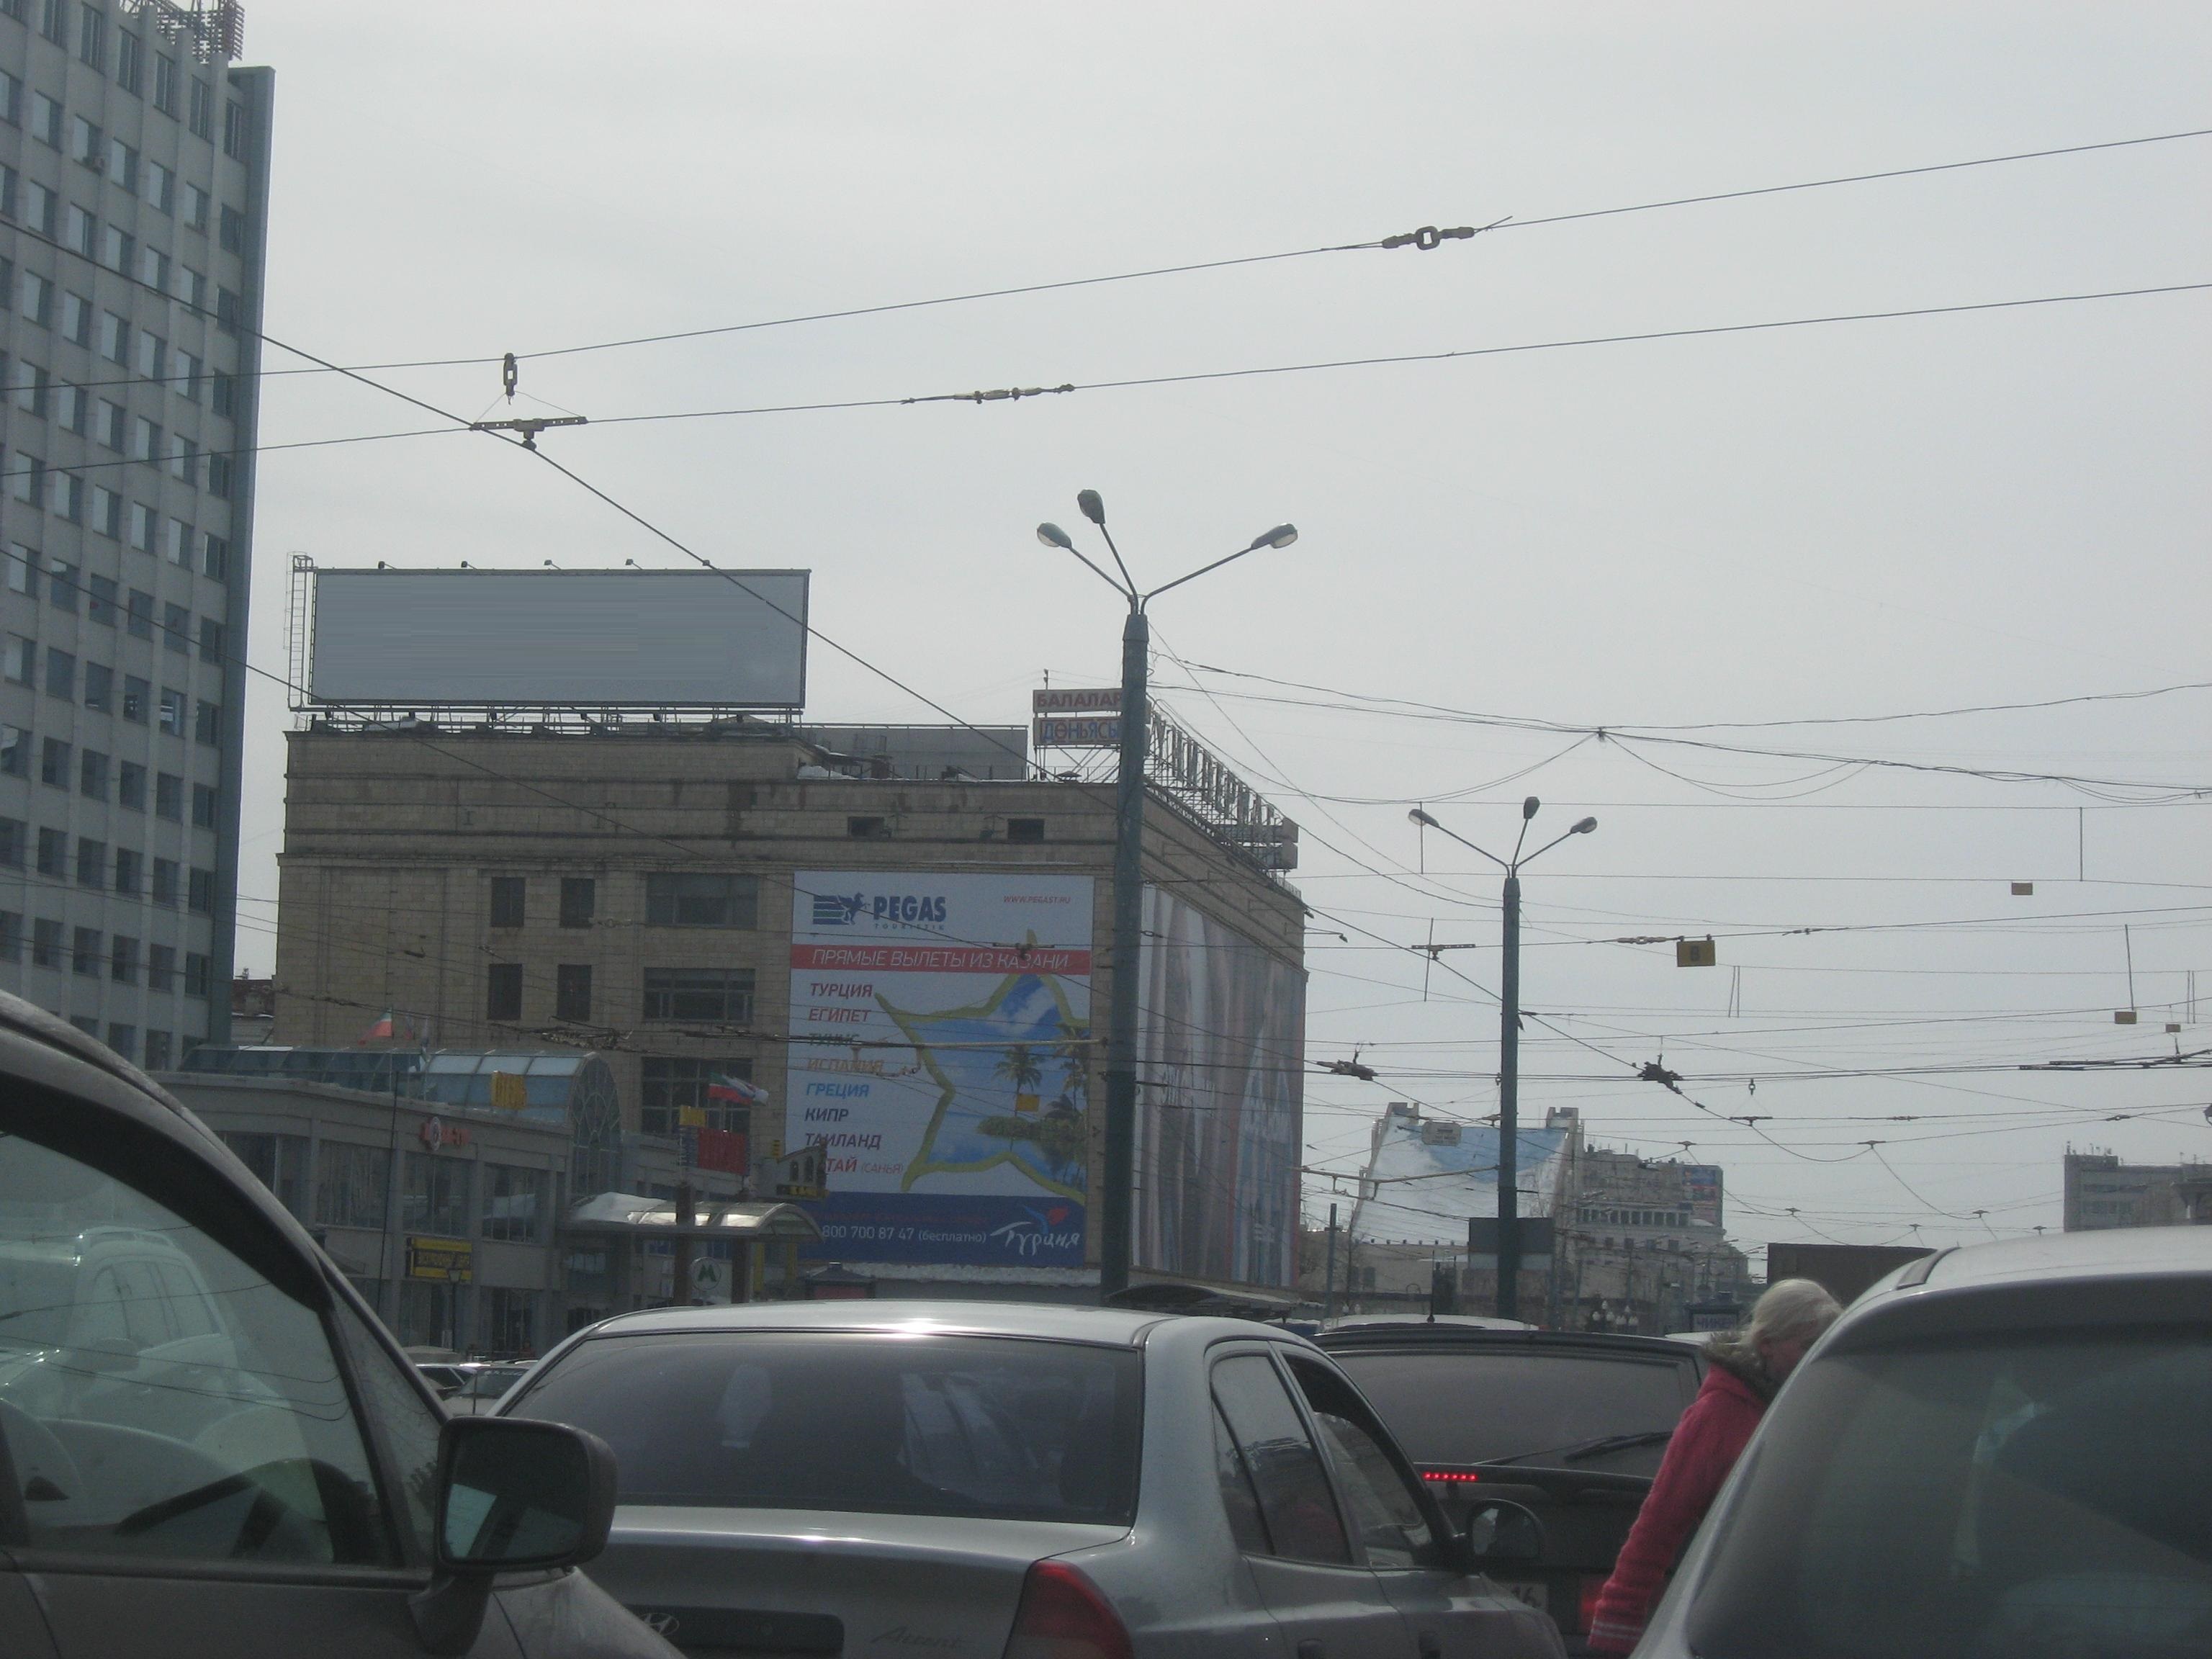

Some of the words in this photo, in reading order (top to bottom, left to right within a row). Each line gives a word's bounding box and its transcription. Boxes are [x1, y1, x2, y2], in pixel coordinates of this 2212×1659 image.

[1036, 691, 1123, 707] БАЛАЛАР
[873, 895, 947, 922] PEGAS
[811, 949, 888, 966] ПРЯМЫЕ
[891, 951, 967, 968] ВЫЛЕТЫ
[969, 953, 993, 968] ИЗ
[997, 953, 1069, 970] КАЗАНИ
[809, 982, 873, 999] ТУРЦИЯ
[808, 1008, 871, 1023] ЕГИПЕТ
[805, 1082, 871, 1100] ГРЕЦИЯ
[804, 1107, 850, 1123] КИПР
[804, 1132, 883, 1151] ТАИЛАНД
[826, 1156, 858, 1173] ТАЙ
[850, 1226, 876, 1240] 700
[878, 1226, 894, 1240] 87
[898, 1227, 915, 1241] 47
[918, 1228, 987, 1244] (бесплатно)
